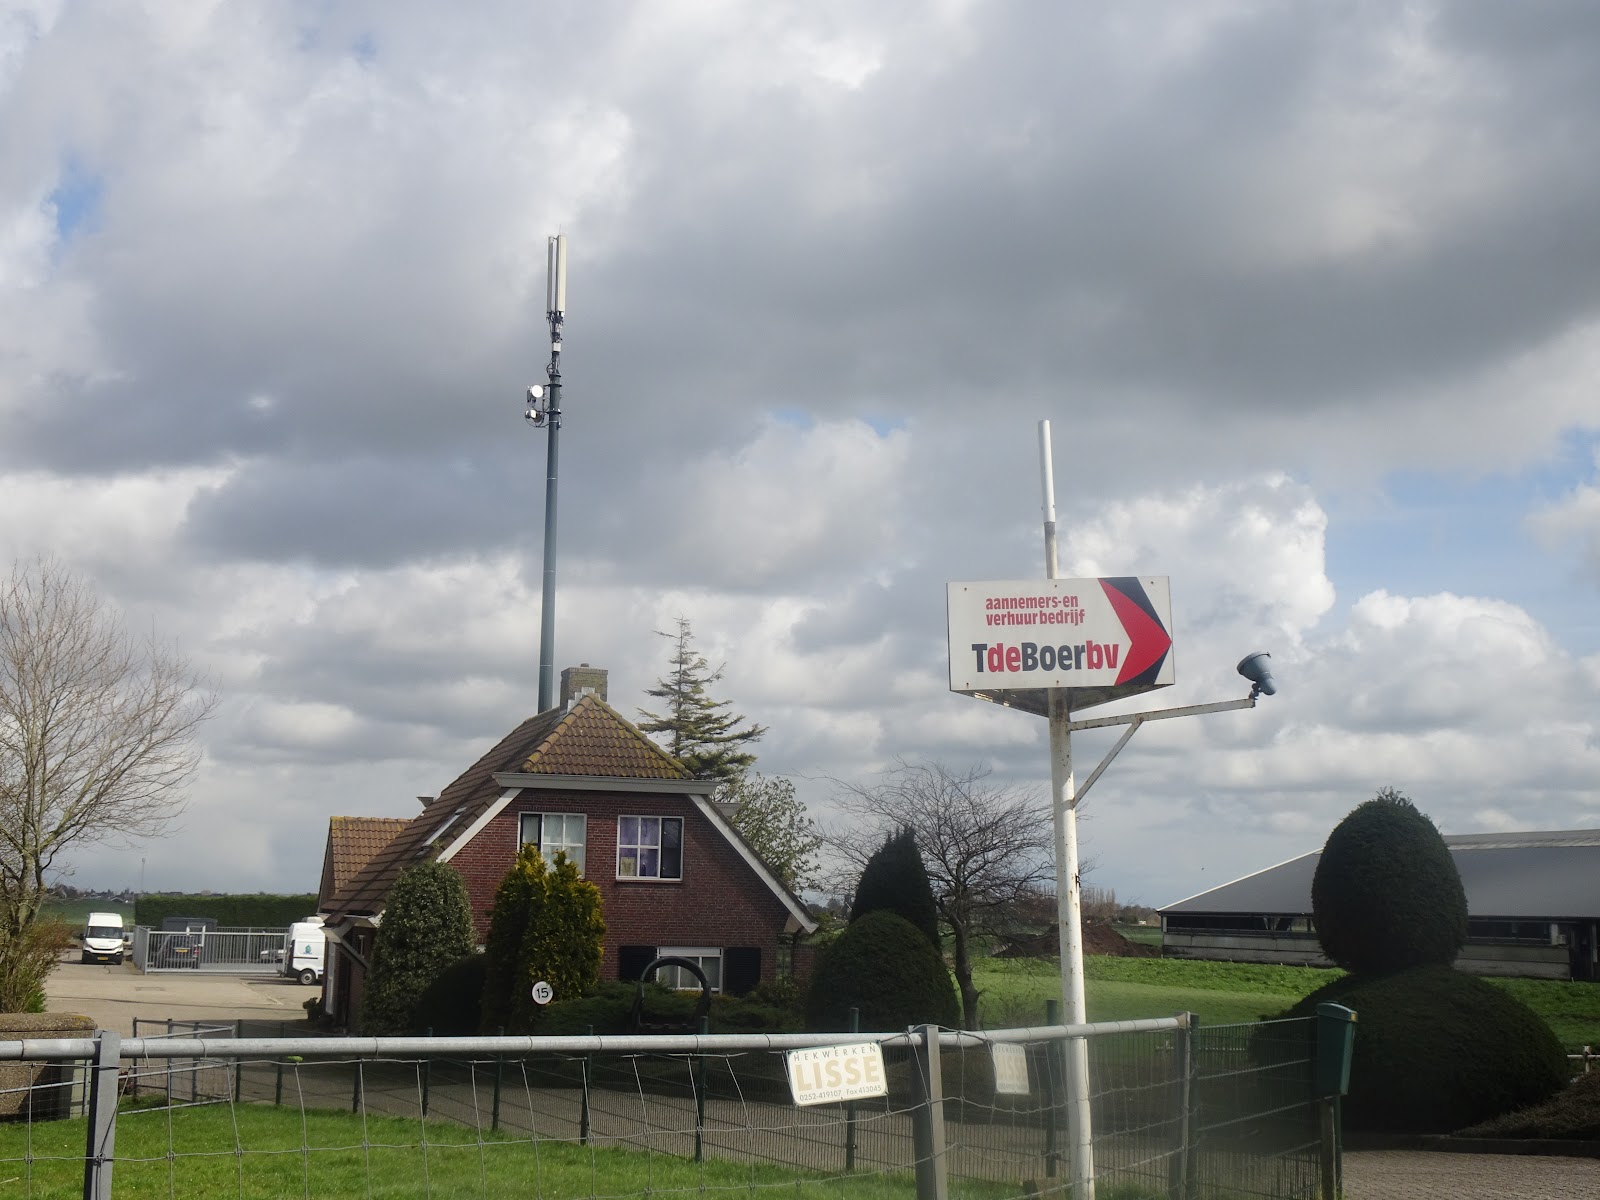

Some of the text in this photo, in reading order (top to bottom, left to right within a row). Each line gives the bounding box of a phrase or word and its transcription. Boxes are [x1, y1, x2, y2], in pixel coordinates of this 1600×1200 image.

[537, 987, 549, 999] 15
[794, 1046, 876, 1062] HEKWERKEN
[795, 1056, 880, 1091] LISSE
[799, 1090, 842, 1102] 0252-419107
